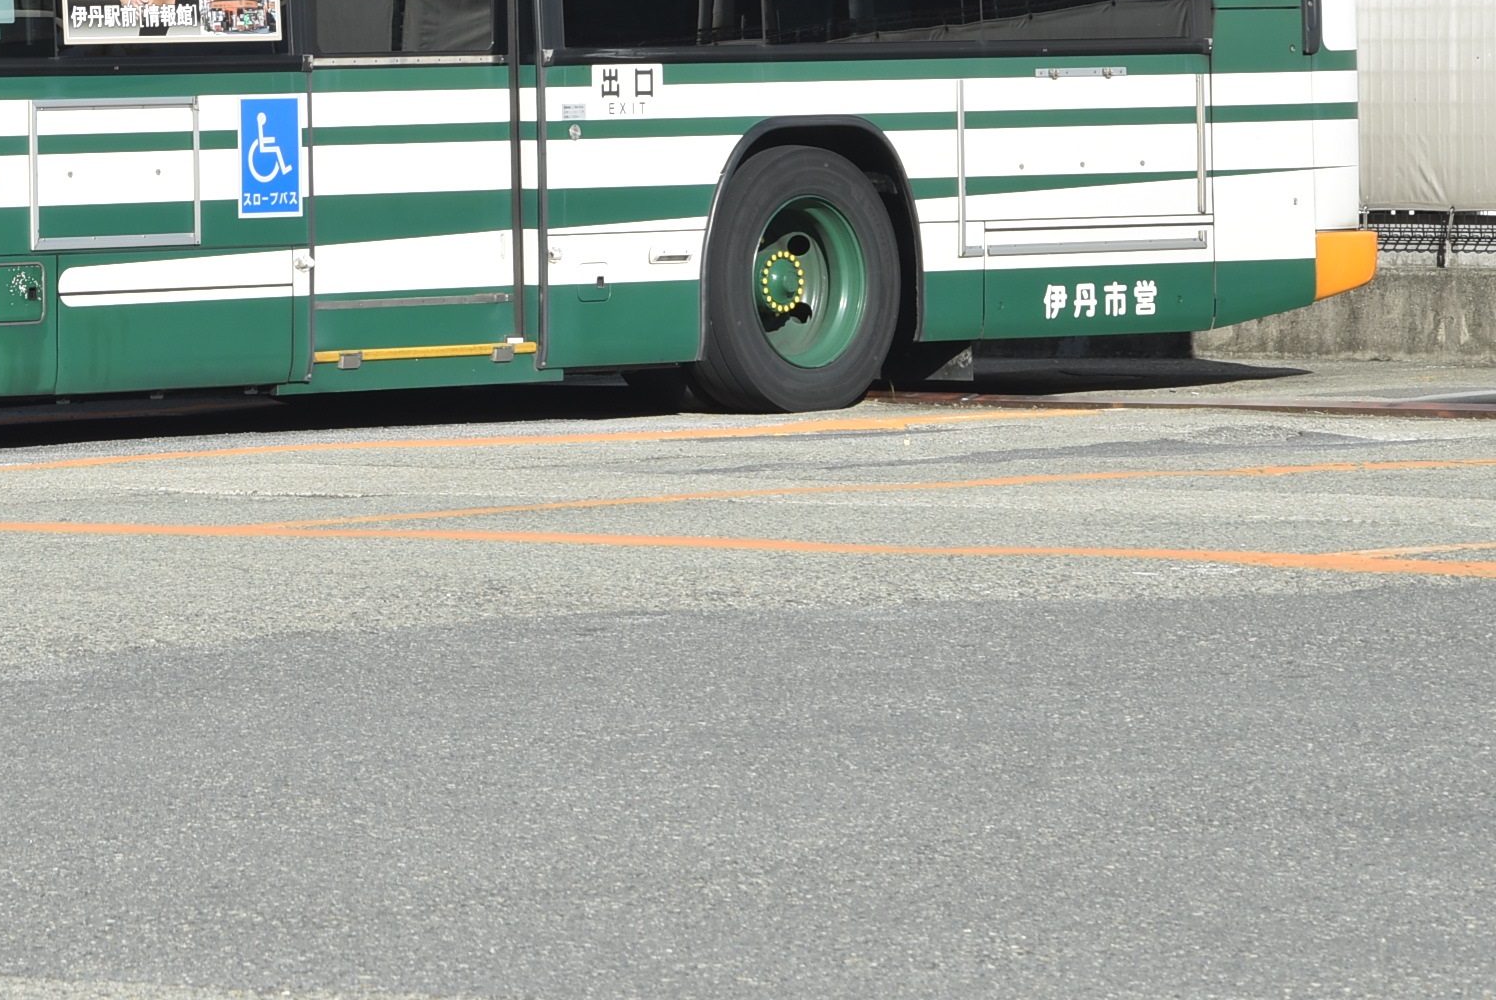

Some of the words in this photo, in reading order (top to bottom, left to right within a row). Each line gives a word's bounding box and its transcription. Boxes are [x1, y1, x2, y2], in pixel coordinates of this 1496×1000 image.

[602, 68, 653, 98] 出口
[609, 102, 645, 114] EXIT
[243, 192, 298, 206] スロープバス
[1043, 280, 1158, 320] 伊丹市営
